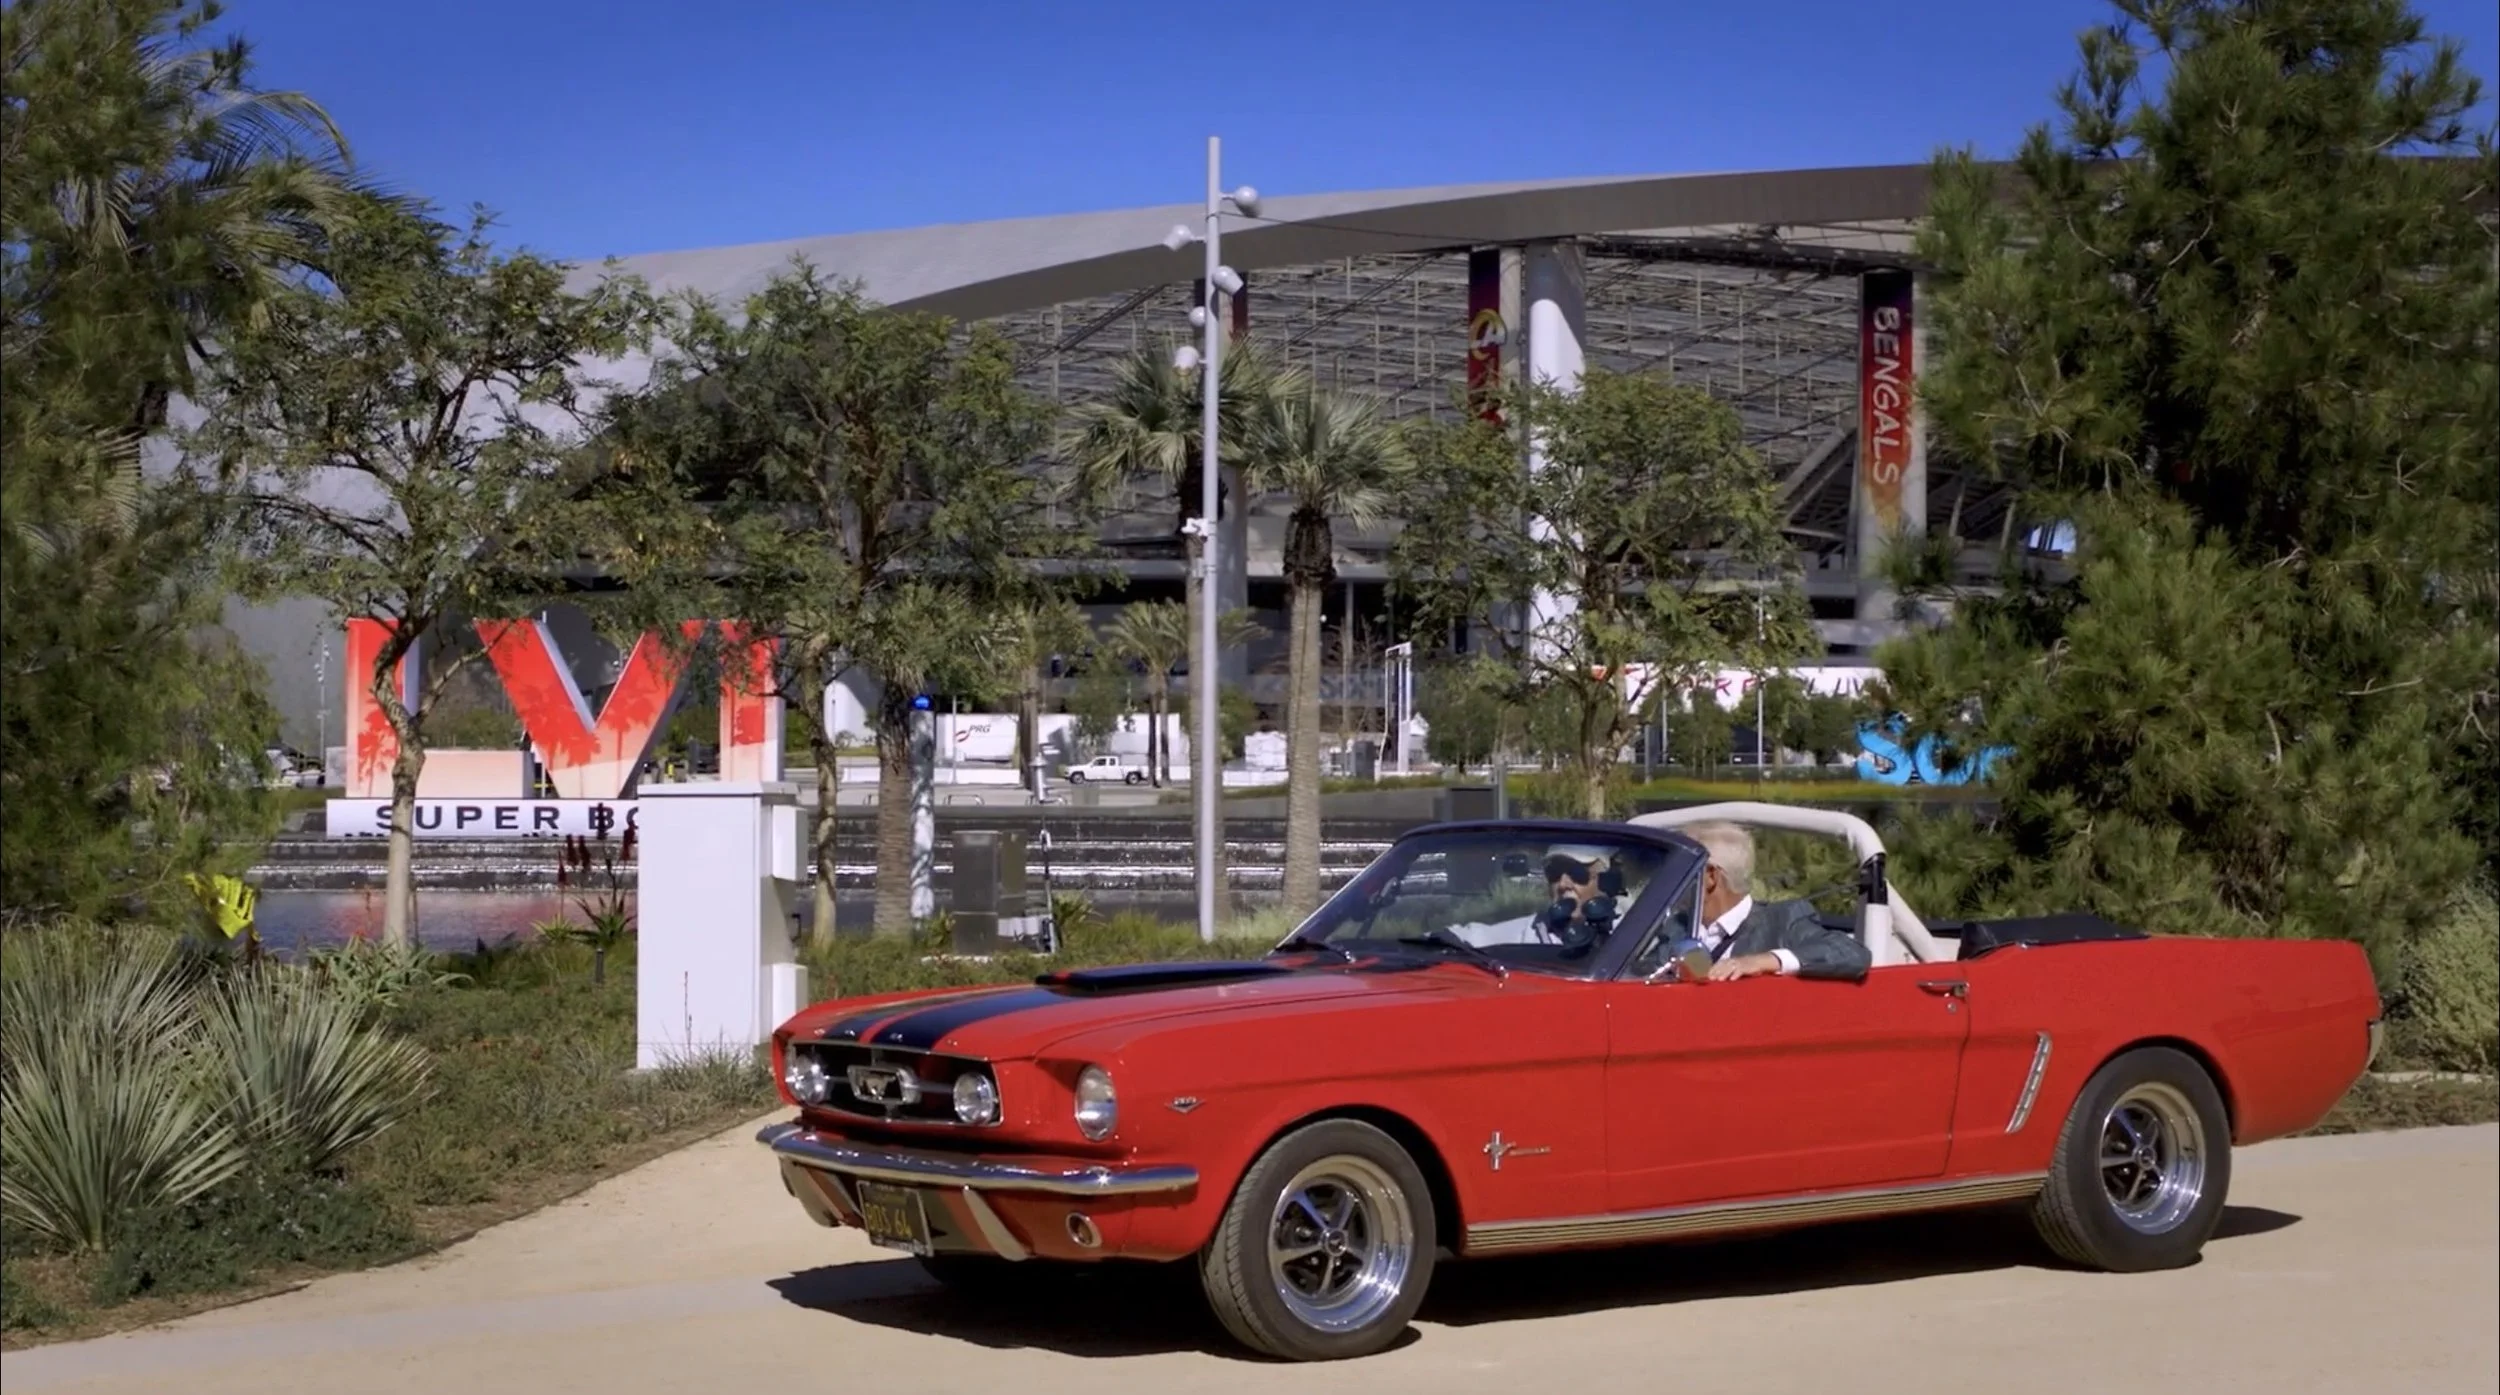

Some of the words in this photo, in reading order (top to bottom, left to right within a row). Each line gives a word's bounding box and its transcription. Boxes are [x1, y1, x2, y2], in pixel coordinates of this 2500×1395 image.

[1873, 306, 1900, 484] BENGALS
[969, 724, 991, 733] PRG
[376, 805, 560, 830] SUPER
